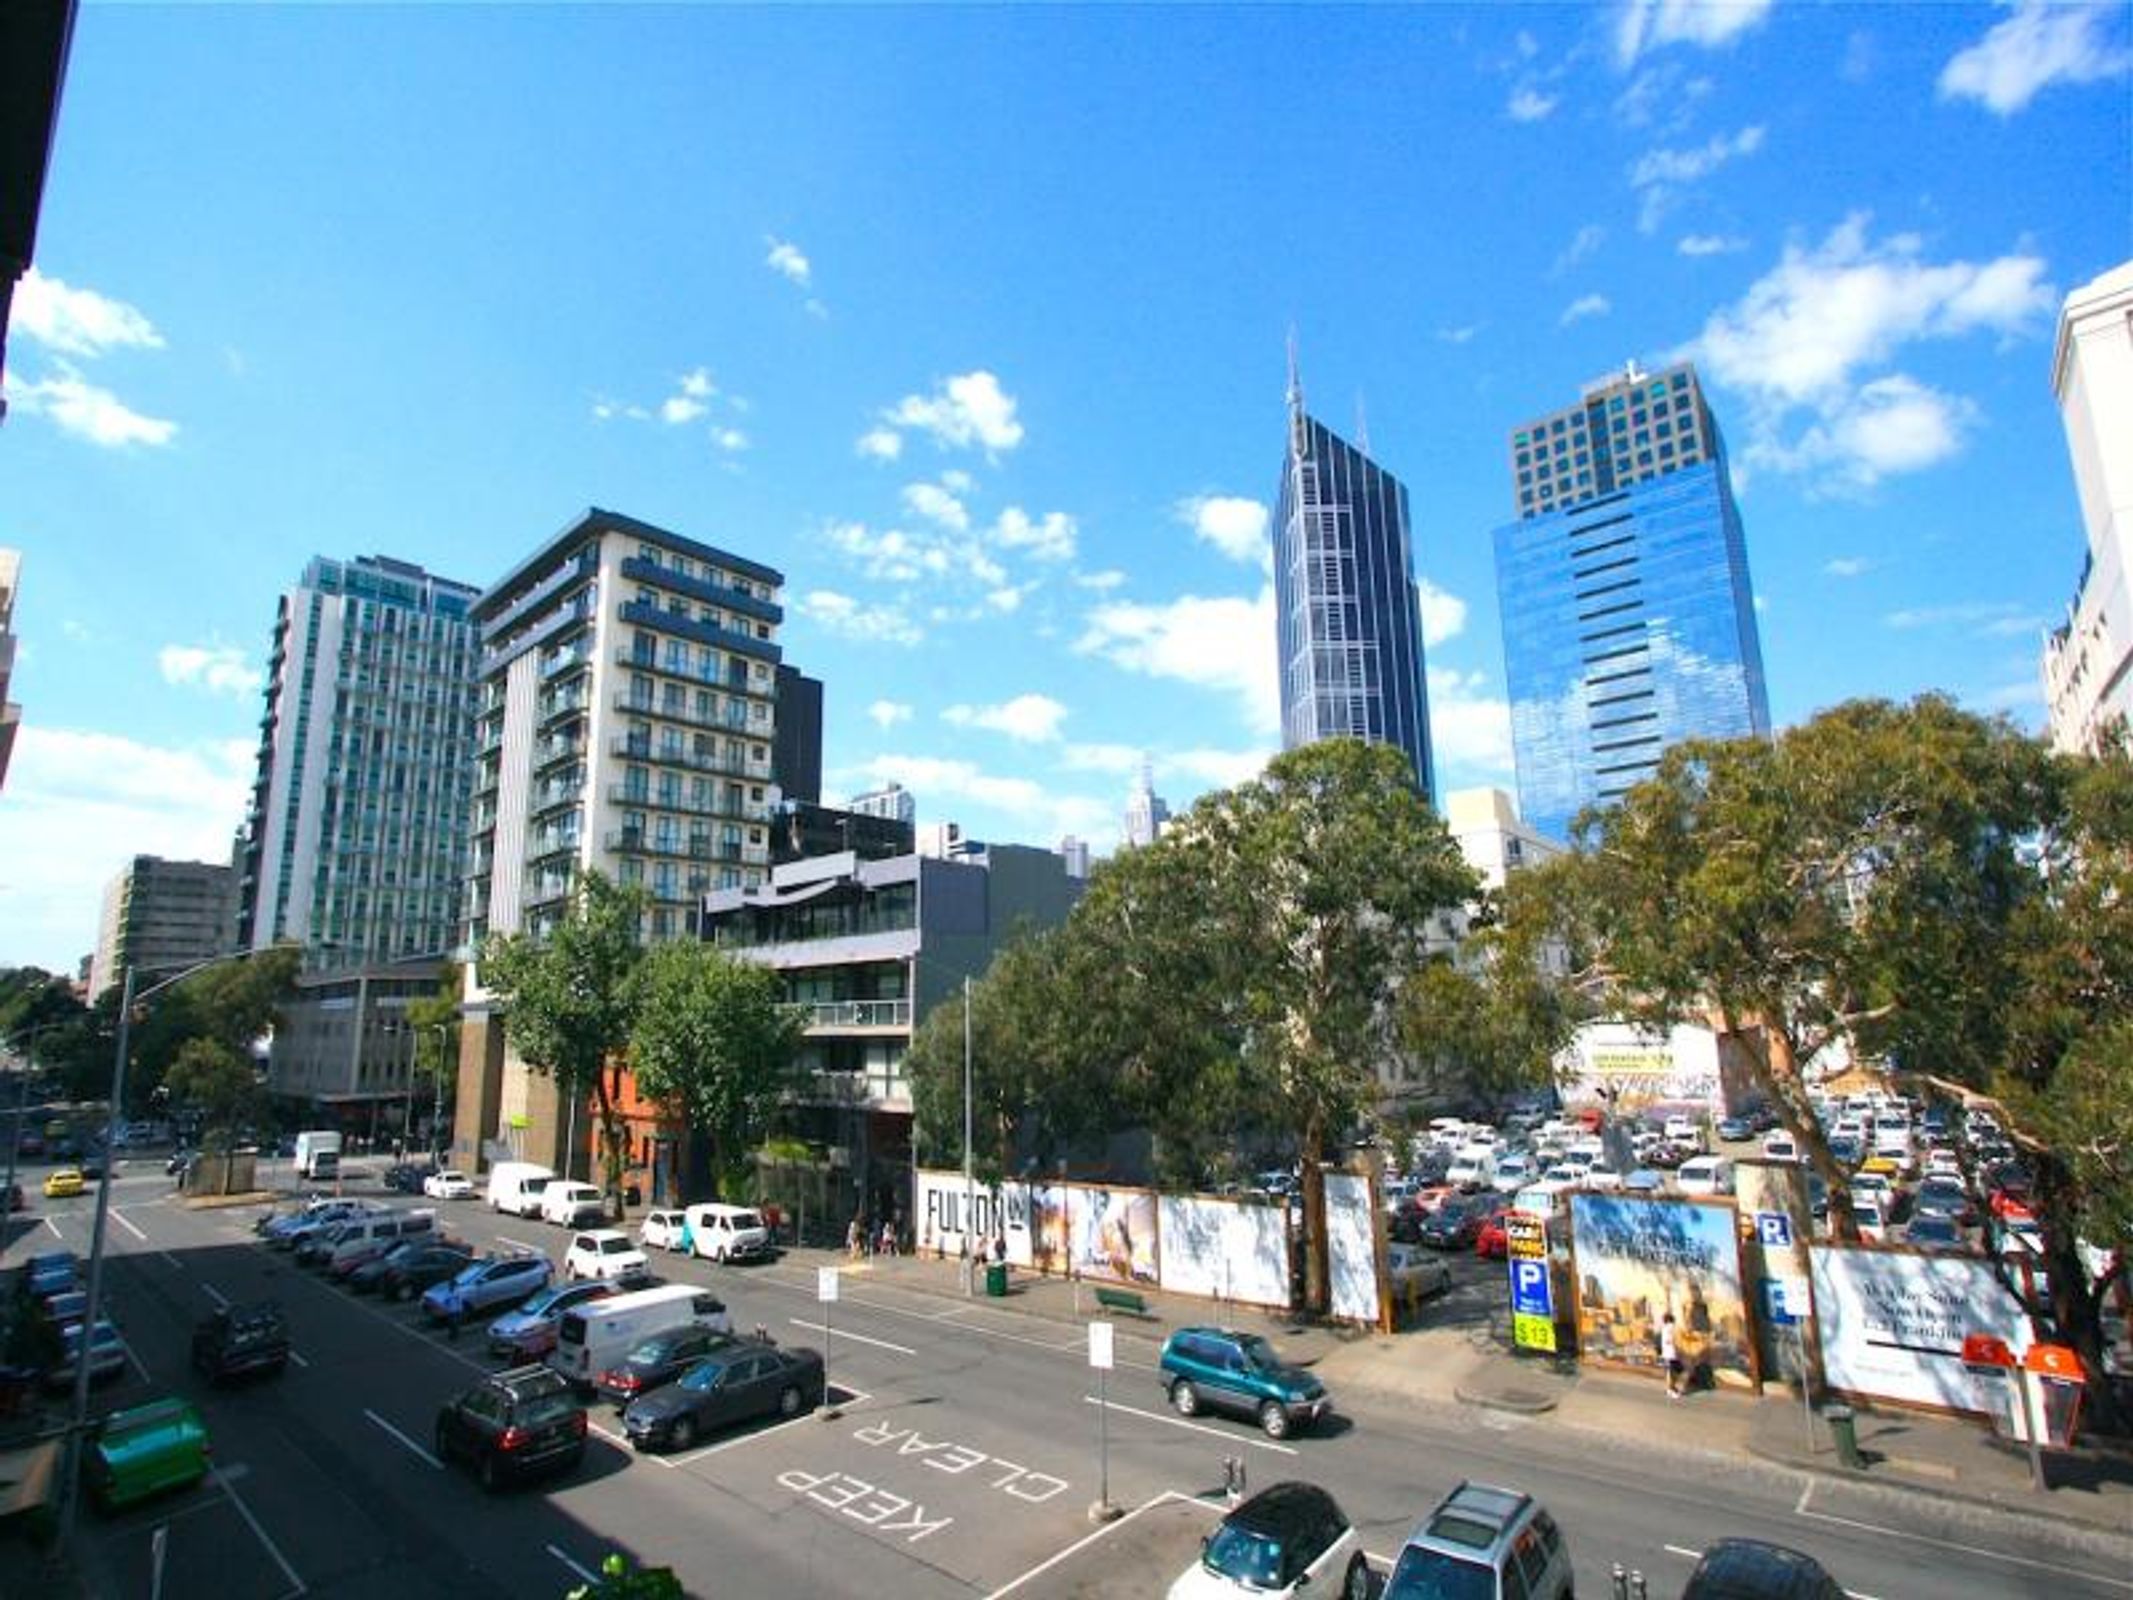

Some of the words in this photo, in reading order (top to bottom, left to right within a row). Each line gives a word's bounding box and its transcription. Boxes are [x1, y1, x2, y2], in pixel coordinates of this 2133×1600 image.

[1520, 1264, 1541, 1293] P
[853, 1421, 1069, 1502] CLEAR
[777, 1471, 954, 1542] KEEP
